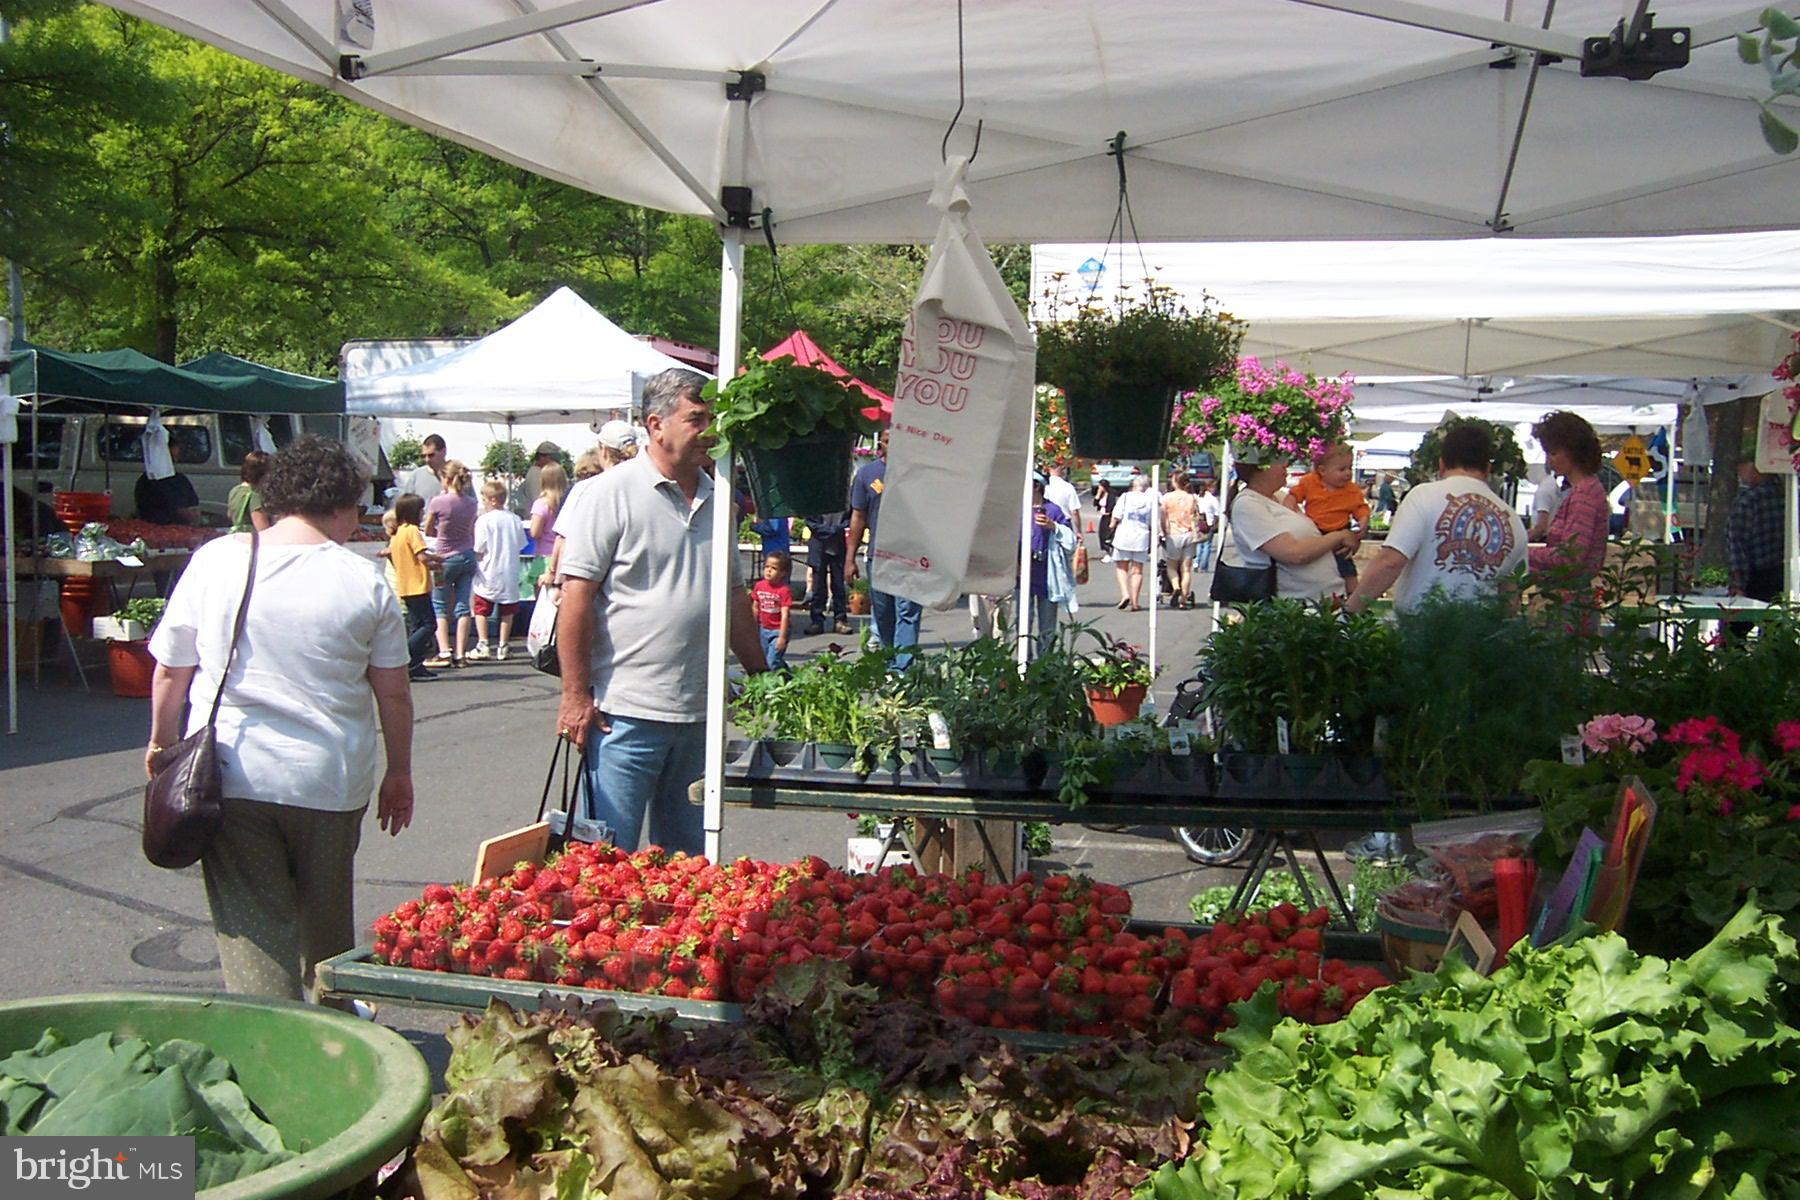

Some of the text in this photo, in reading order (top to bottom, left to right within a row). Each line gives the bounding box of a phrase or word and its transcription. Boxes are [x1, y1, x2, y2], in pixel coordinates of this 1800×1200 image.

[896, 371, 968, 412] YOU
[906, 425, 928, 438] Nice
[933, 432, 953, 446] Day
